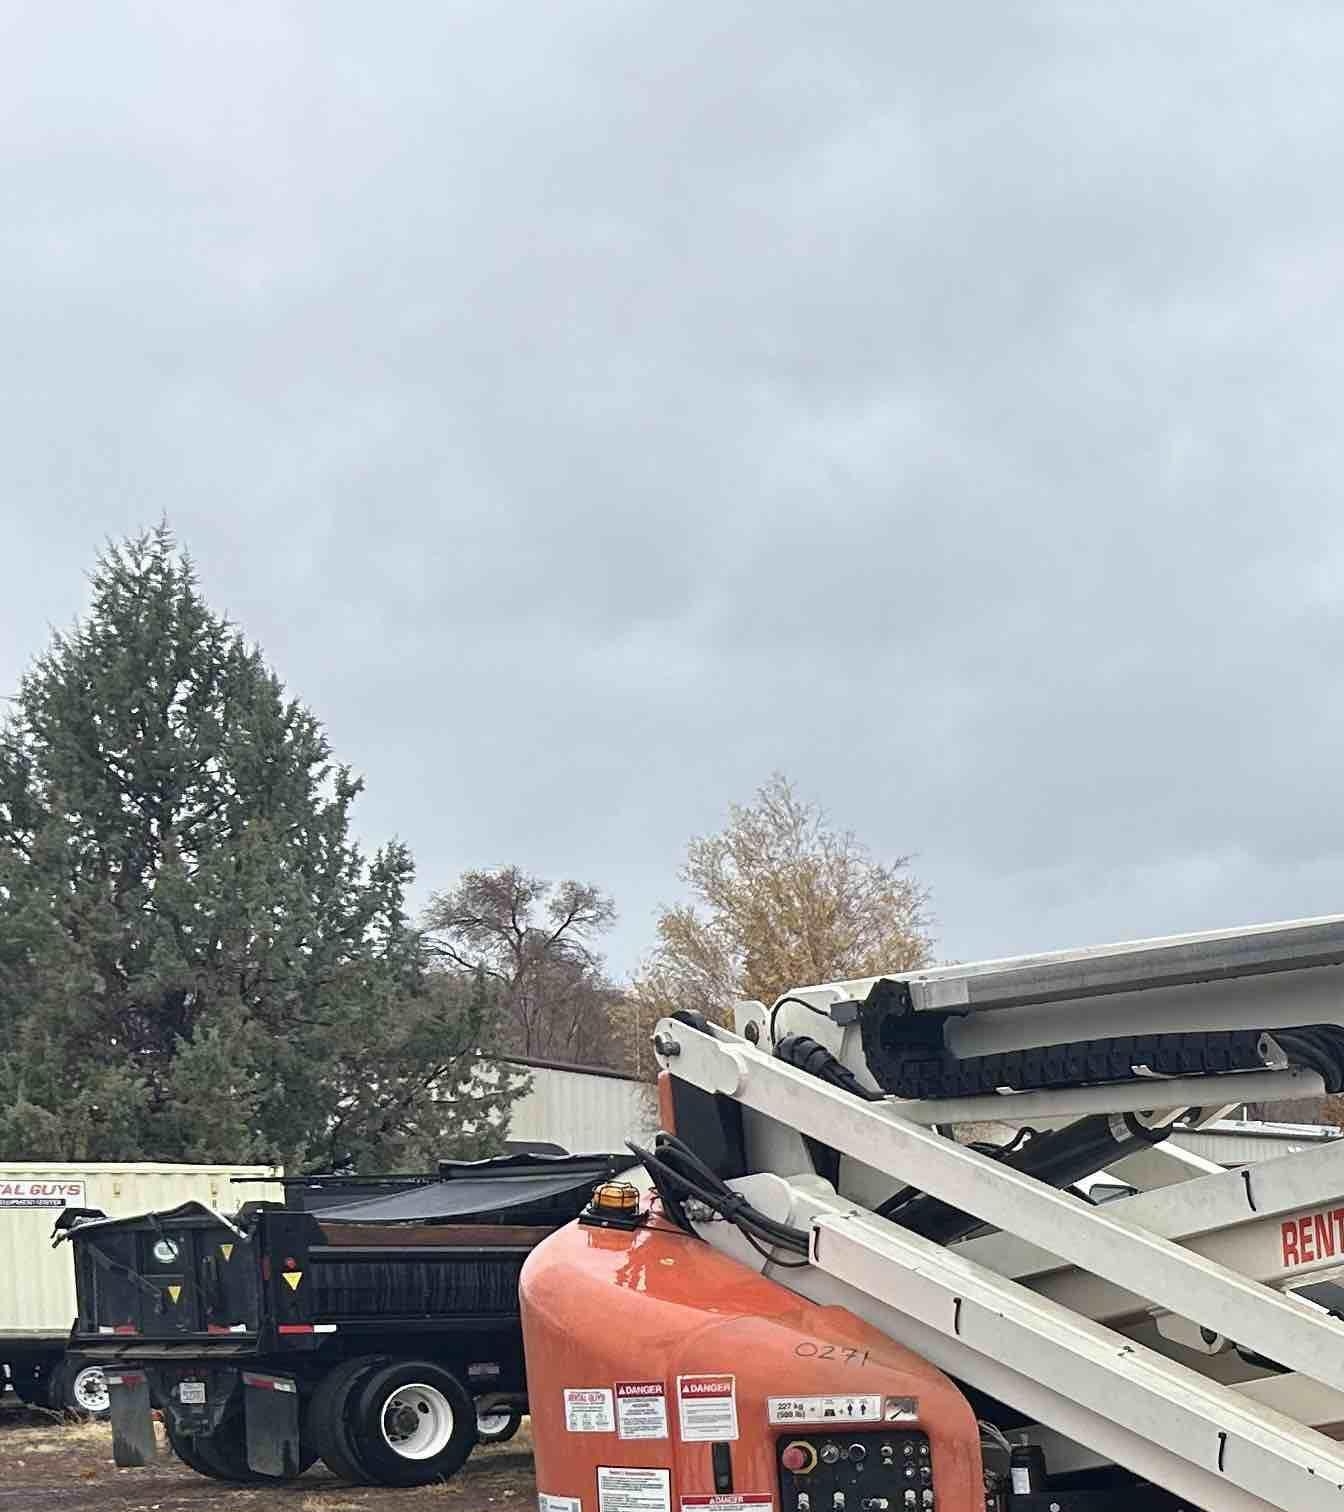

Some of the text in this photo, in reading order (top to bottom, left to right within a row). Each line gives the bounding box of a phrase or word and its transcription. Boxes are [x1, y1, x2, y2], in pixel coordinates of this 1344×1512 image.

[0, 1184, 81, 1196] AL GUYS
[795, 1342, 870, 1366] 0271
[626, 1384, 663, 1394] DANGER
[690, 1383, 731, 1393] DANGER
